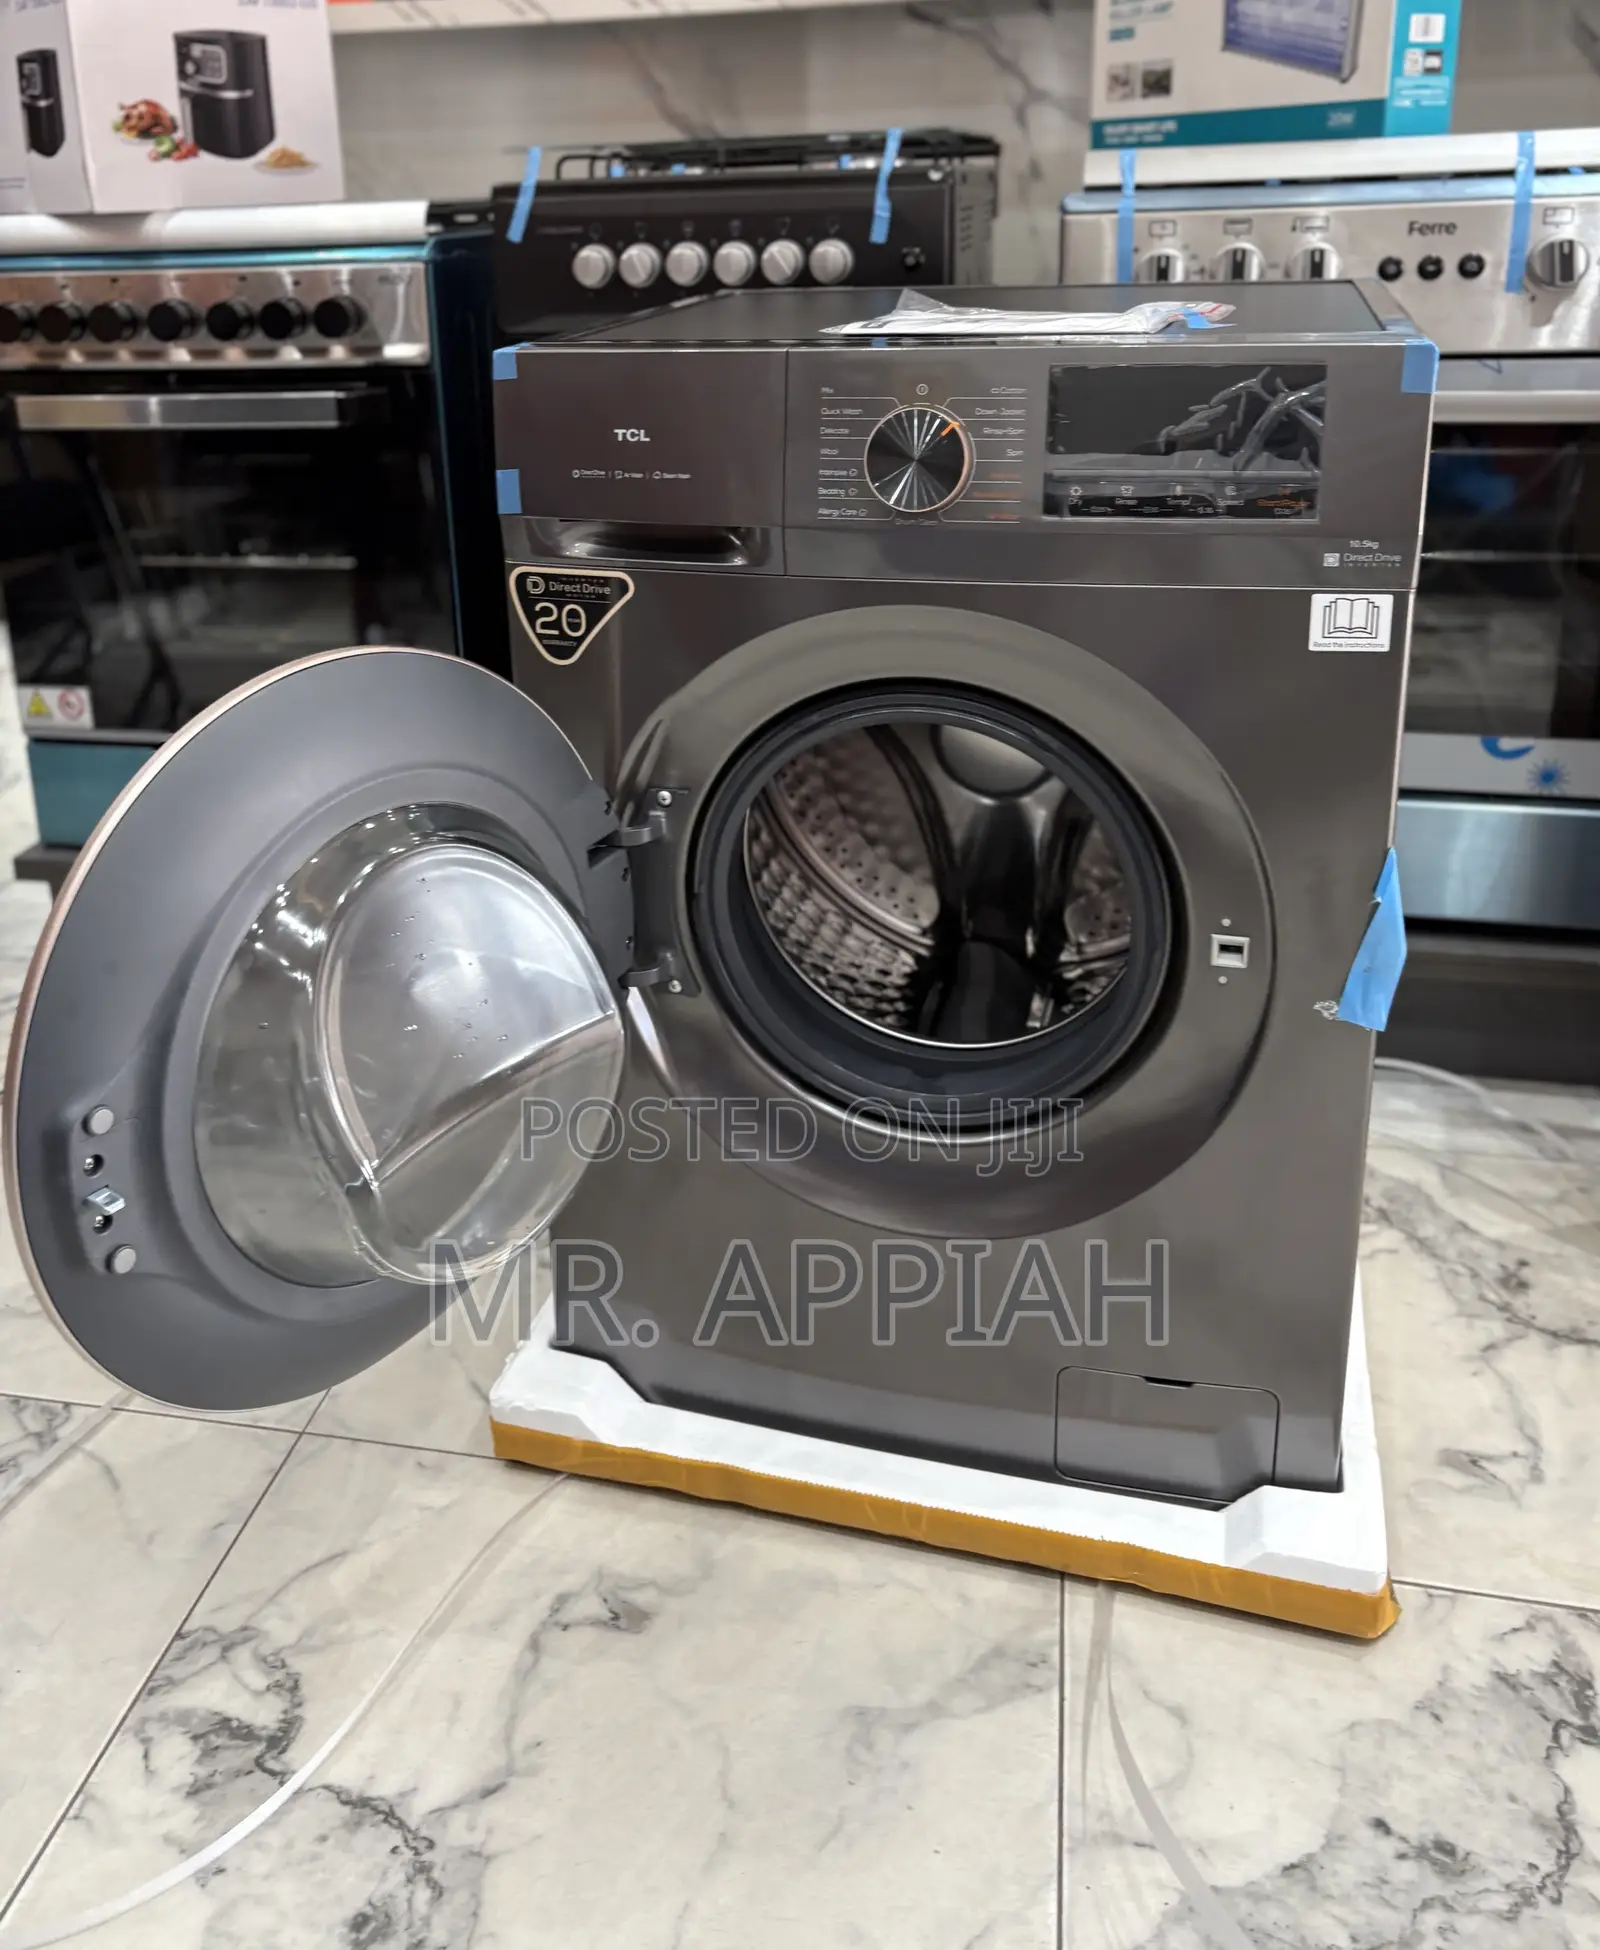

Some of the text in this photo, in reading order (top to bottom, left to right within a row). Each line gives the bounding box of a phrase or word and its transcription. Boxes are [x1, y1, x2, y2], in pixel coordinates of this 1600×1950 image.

[1407, 220, 1458, 237] Ferre
[613, 428, 651, 442] TCL
[1343, 552, 1402, 562] Direct Drive
[548, 581, 582, 593] Direct
[582, 583, 612, 595] Drive
[534, 601, 587, 638] 20
